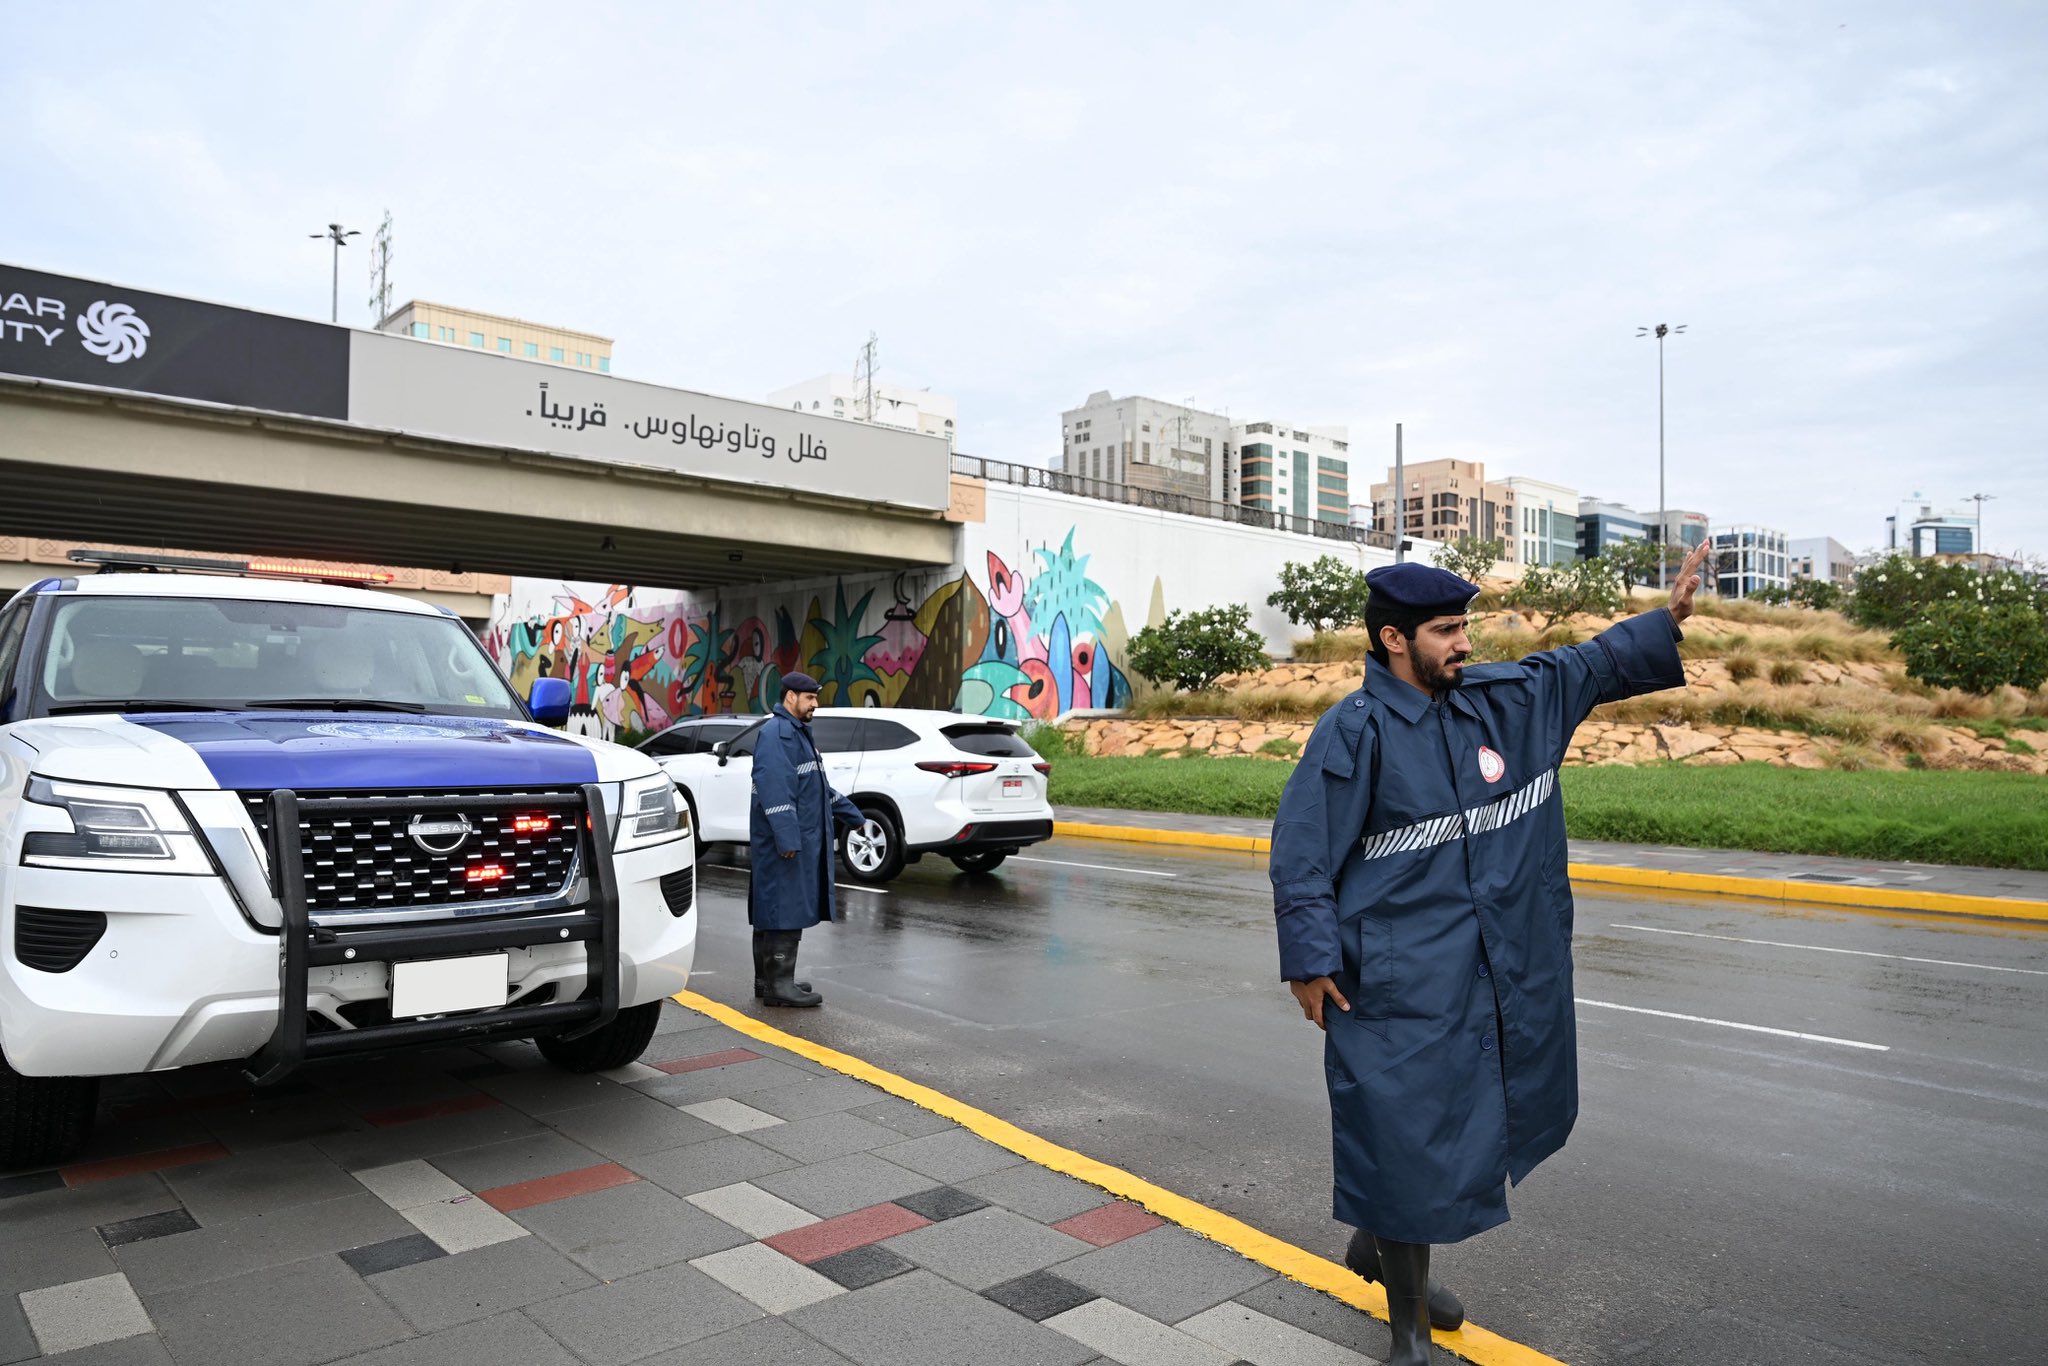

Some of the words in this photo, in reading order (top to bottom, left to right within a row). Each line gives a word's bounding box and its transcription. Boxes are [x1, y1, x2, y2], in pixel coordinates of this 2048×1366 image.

[0, 292, 66, 321] AR
[624, 413, 776, 459] وتاونهاوس.
[787, 432, 827, 463] فلل
[410, 823, 472, 833] NISSAN
